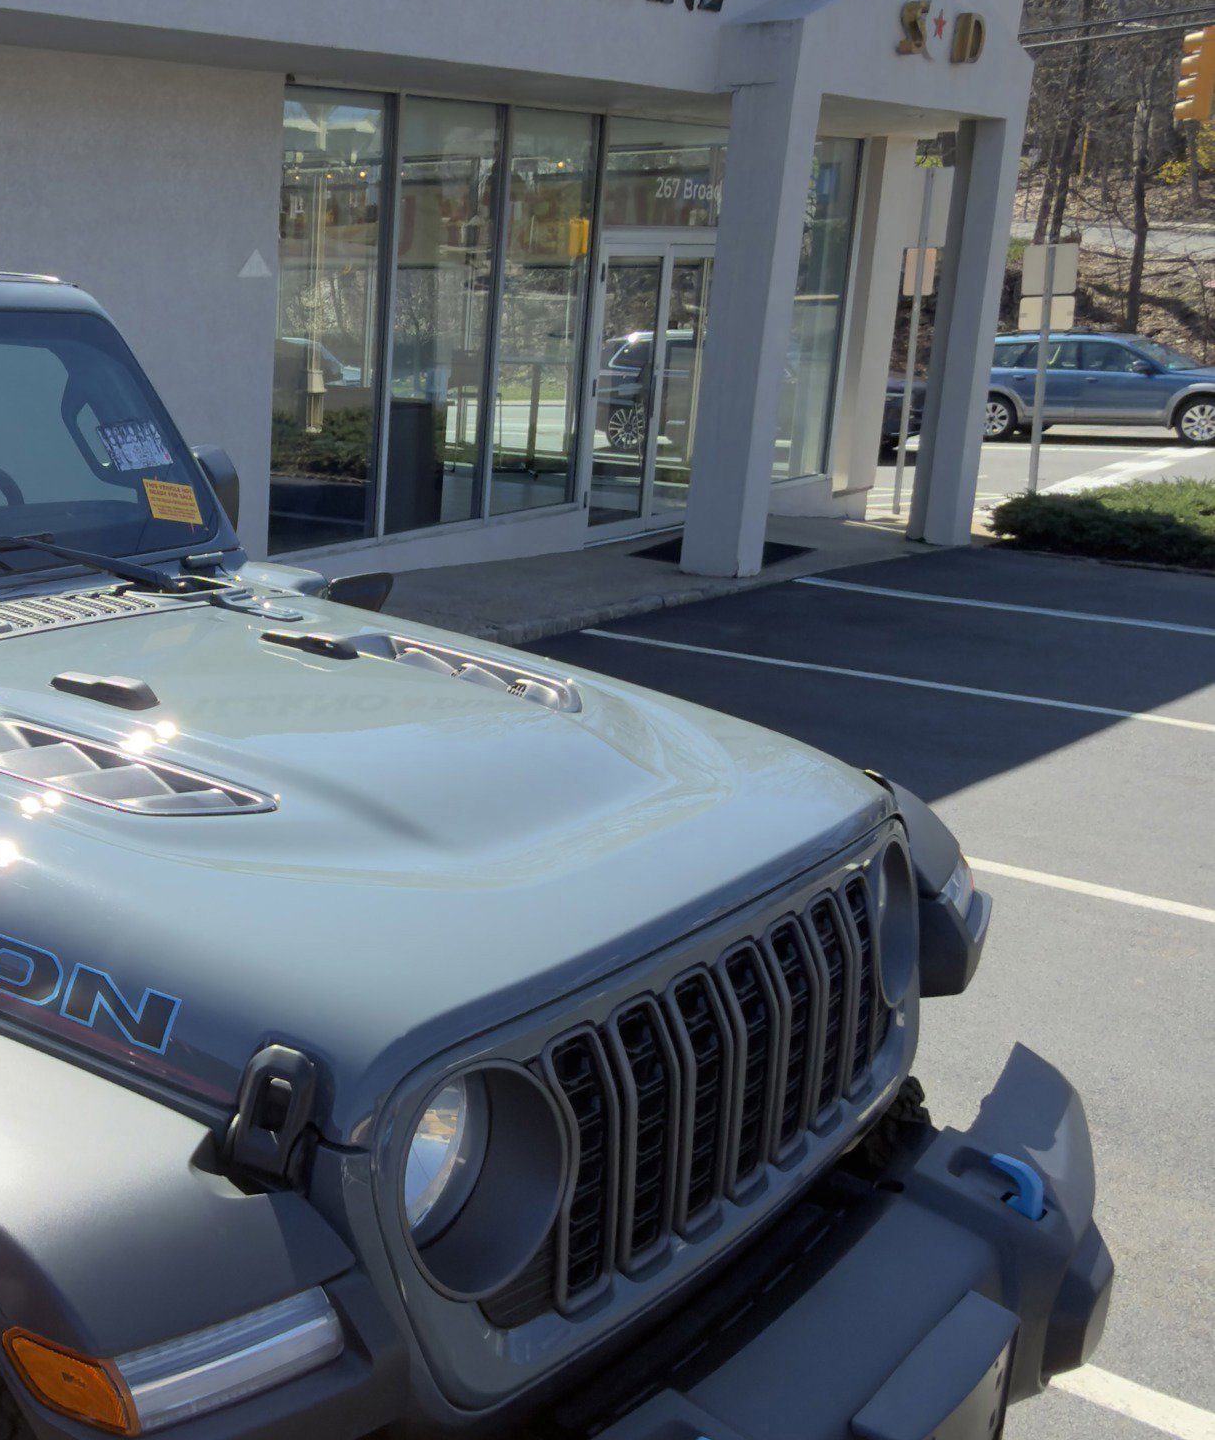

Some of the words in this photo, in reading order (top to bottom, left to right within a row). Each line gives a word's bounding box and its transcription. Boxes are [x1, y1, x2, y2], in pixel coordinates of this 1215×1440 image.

[896, 0, 931, 56] S
[951, 12, 986, 64] D
[655, 176, 681, 199] 267
